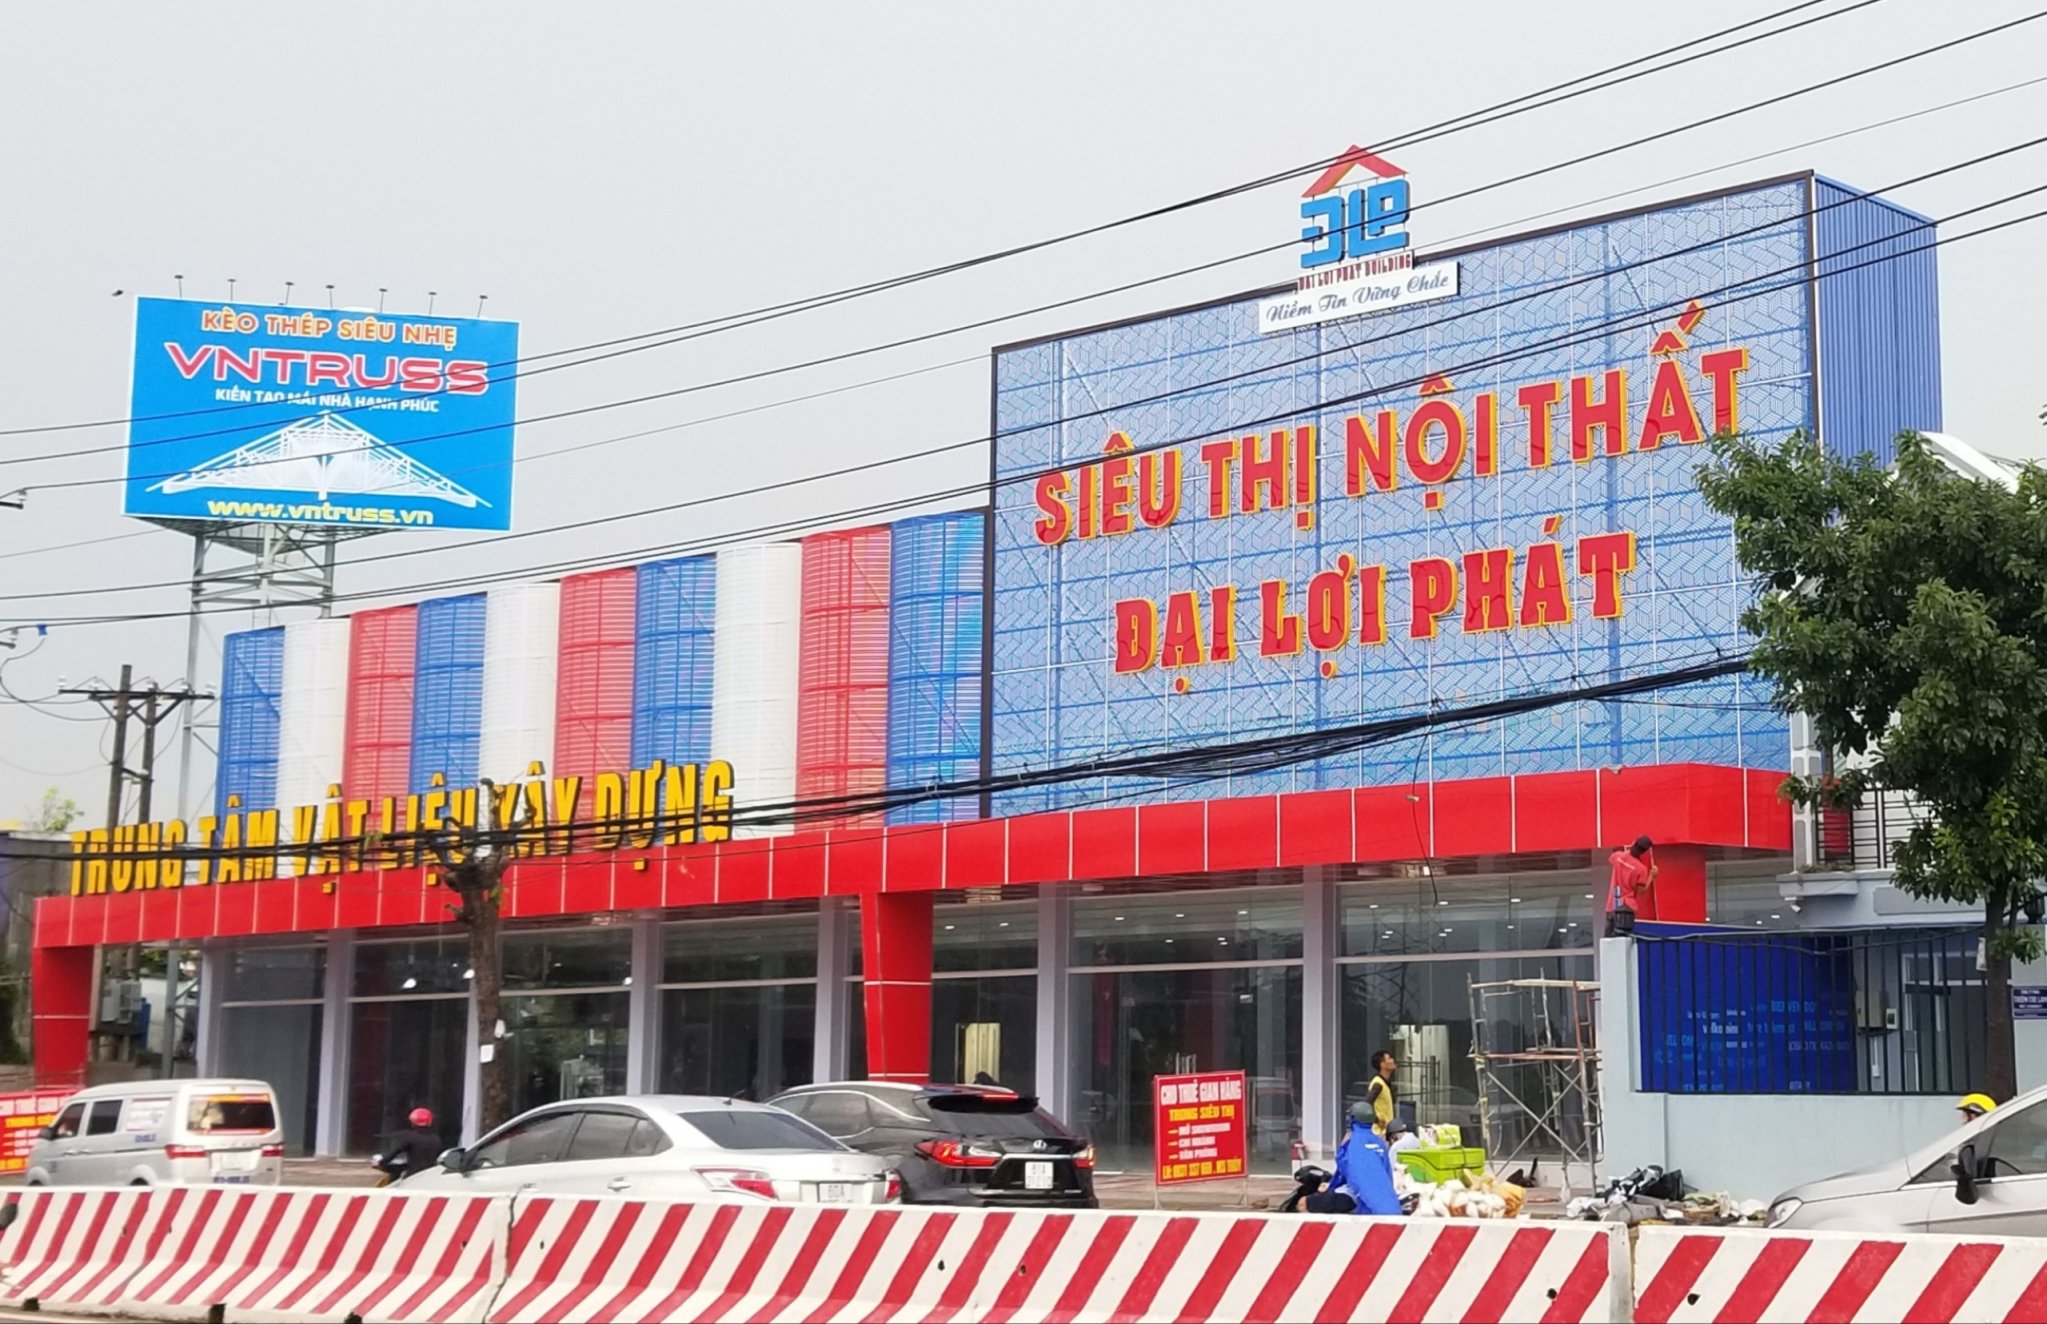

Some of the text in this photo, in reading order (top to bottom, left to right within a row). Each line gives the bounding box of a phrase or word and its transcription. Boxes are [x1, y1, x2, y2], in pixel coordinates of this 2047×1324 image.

[1318, 293, 1347, 312] Tin
[202, 307, 457, 350] KÈO THÉP SIÊU NHẸ
[164, 342, 489, 395] VNTRUSS
[287, 391, 316, 406] MÁI
[320, 393, 352, 408] NHÀ
[400, 397, 440, 413] PHÚC
[1033, 298, 1749, 546] SIÊU THỊ NỘI THẤT
[207, 500, 434, 526] www.vntruss.vn
[1113, 514, 1636, 695] ĐẠI LỢI PHÁT
[70, 818, 188, 897] TRUNG
[197, 794, 281, 886] TÂM
[292, 783, 372, 895] VẬT
[379, 772, 480, 886] LIỆU
[593, 758, 735, 871] DỰNG
